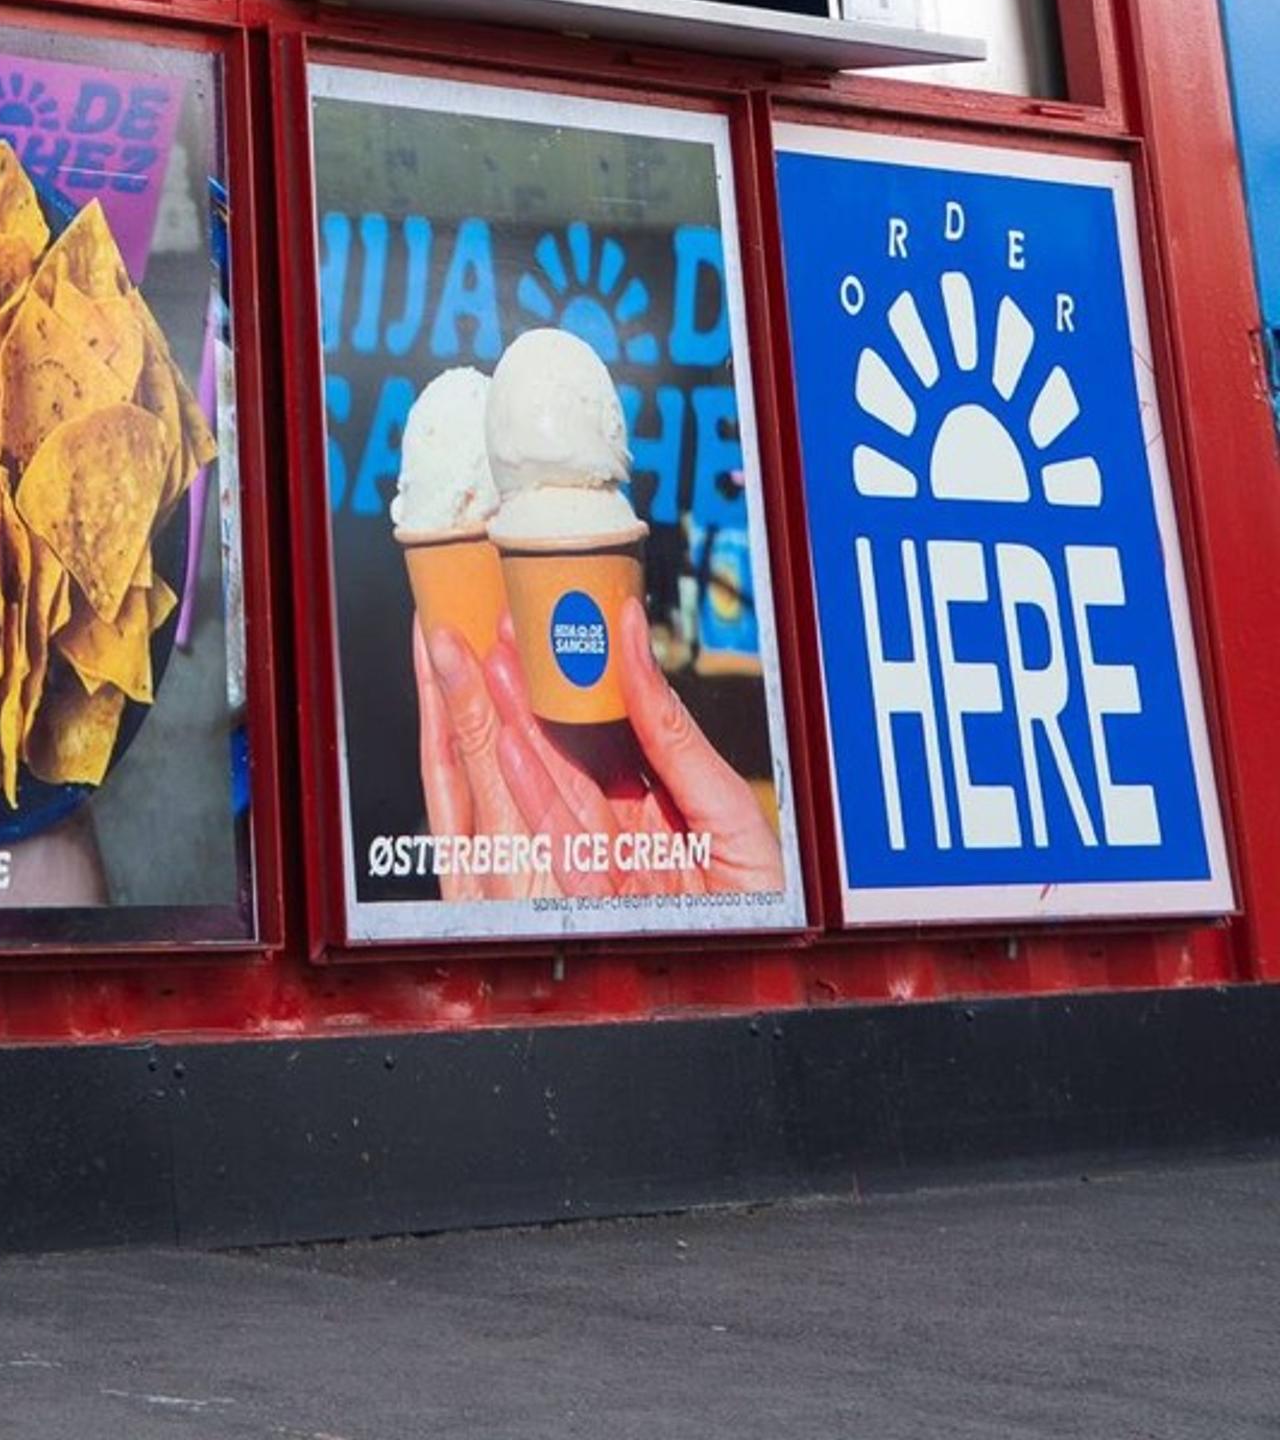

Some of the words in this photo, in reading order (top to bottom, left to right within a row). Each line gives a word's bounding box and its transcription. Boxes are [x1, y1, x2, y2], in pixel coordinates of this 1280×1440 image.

[67, 82, 170, 141] DE
[841, 201, 1075, 334] ORDER
[856, 536, 1162, 850] HERE
[368, 833, 553, 876] ØSTERBERG
[562, 834, 610, 873] ICE
[614, 831, 713, 873] CREAM
